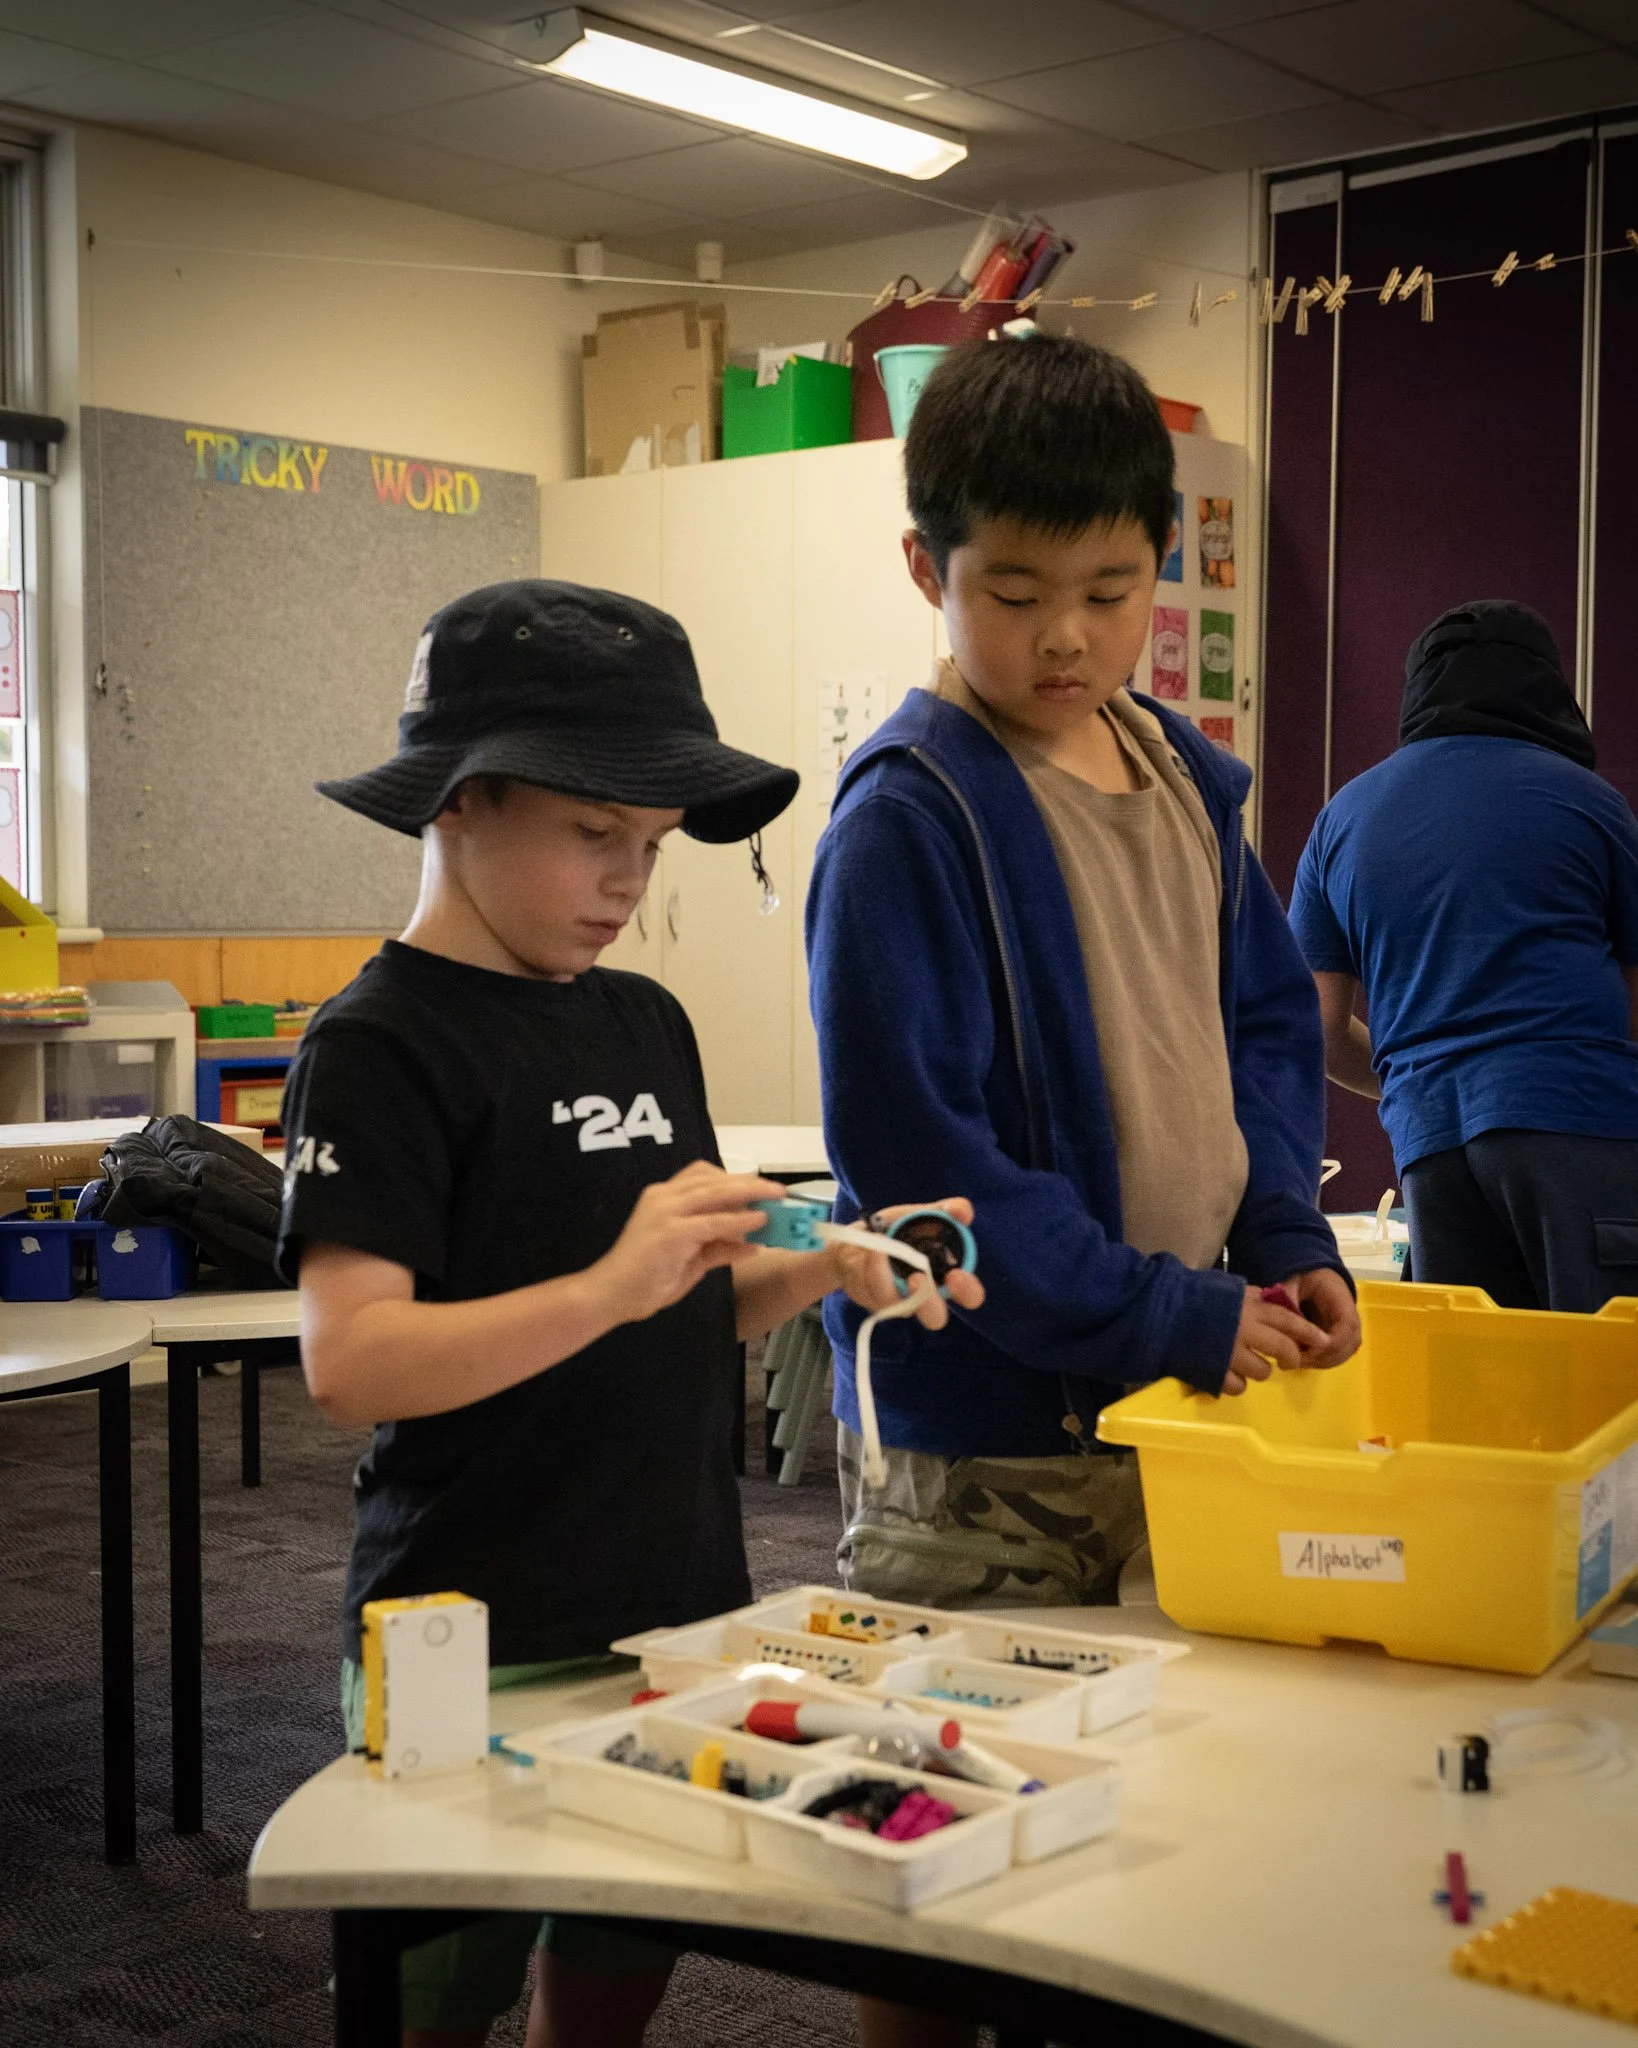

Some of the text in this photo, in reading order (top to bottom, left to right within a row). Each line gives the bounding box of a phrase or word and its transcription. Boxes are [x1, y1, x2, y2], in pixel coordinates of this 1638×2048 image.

[371, 455, 480, 517] WORD
[552, 1093, 673, 1153] '24
[1296, 1539, 1383, 1578] Alphabet
